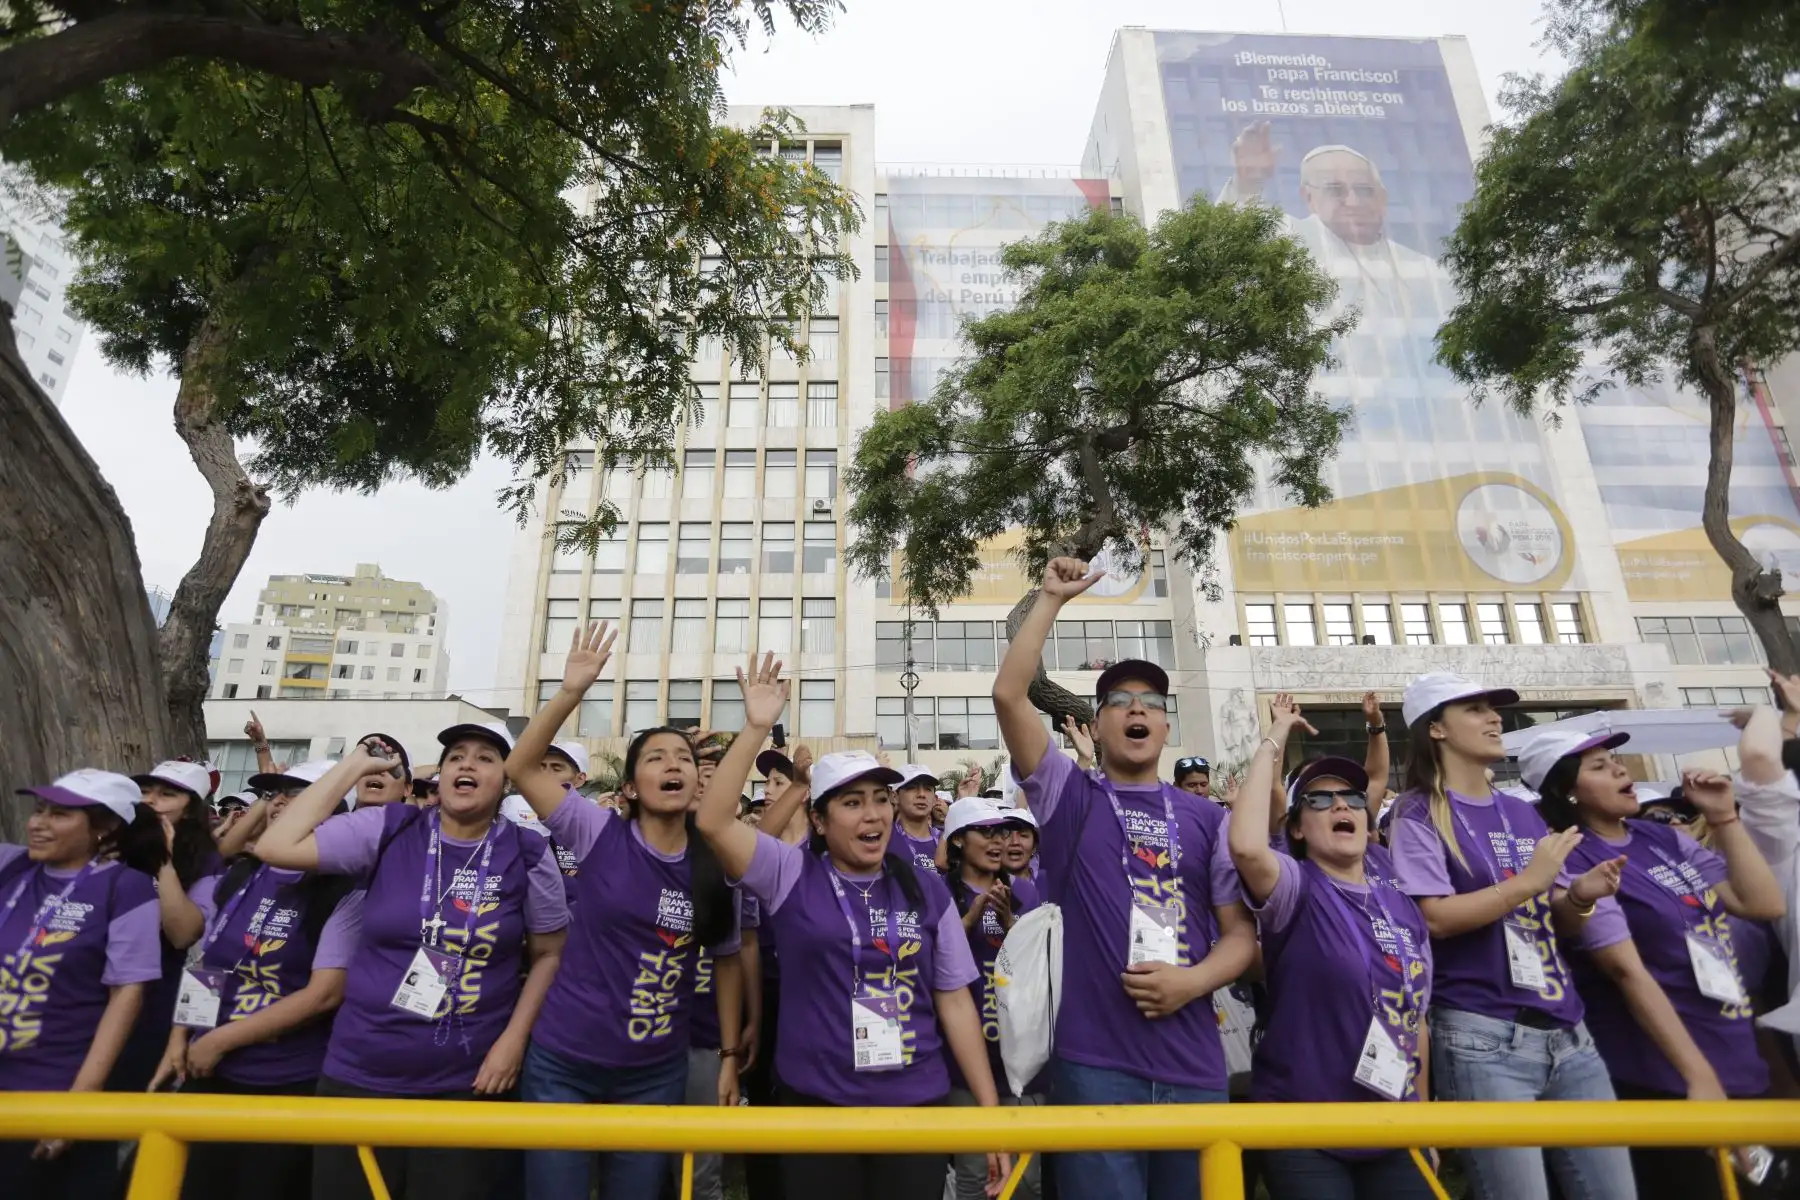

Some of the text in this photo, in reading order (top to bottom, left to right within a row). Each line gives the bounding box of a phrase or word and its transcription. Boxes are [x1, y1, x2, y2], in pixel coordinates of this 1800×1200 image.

[1234, 52, 1332, 69] ¡Bienvenido,
[1267, 67, 1400, 84] papa Francisco!
[1259, 85, 1404, 105] Te recibimos con
[1221, 97, 1385, 116] los brazos abiertos
[925, 287, 953, 304] del
[960, 287, 1004, 304] Perú
[1125, 809, 1151, 819] PAPA
[1126, 817, 1168, 829] FRANCIS
[1126, 822, 1151, 833] LIMA
[1144, 840, 1169, 848] ESPERA
[454, 868, 478, 876] PAPA
[453, 875, 503, 883] FRANSCO
[661, 888, 684, 900] PAPA
[659, 896, 692, 909] FRANCI
[683, 908, 694, 918] 20
[670, 923, 692, 932] ESPERA
[454, 921, 500, 1015] VOLUN
[229, 960, 263, 1021] TARI
[628, 949, 667, 1042] TARIO
[9, 952, 64, 1051] VOLUN
